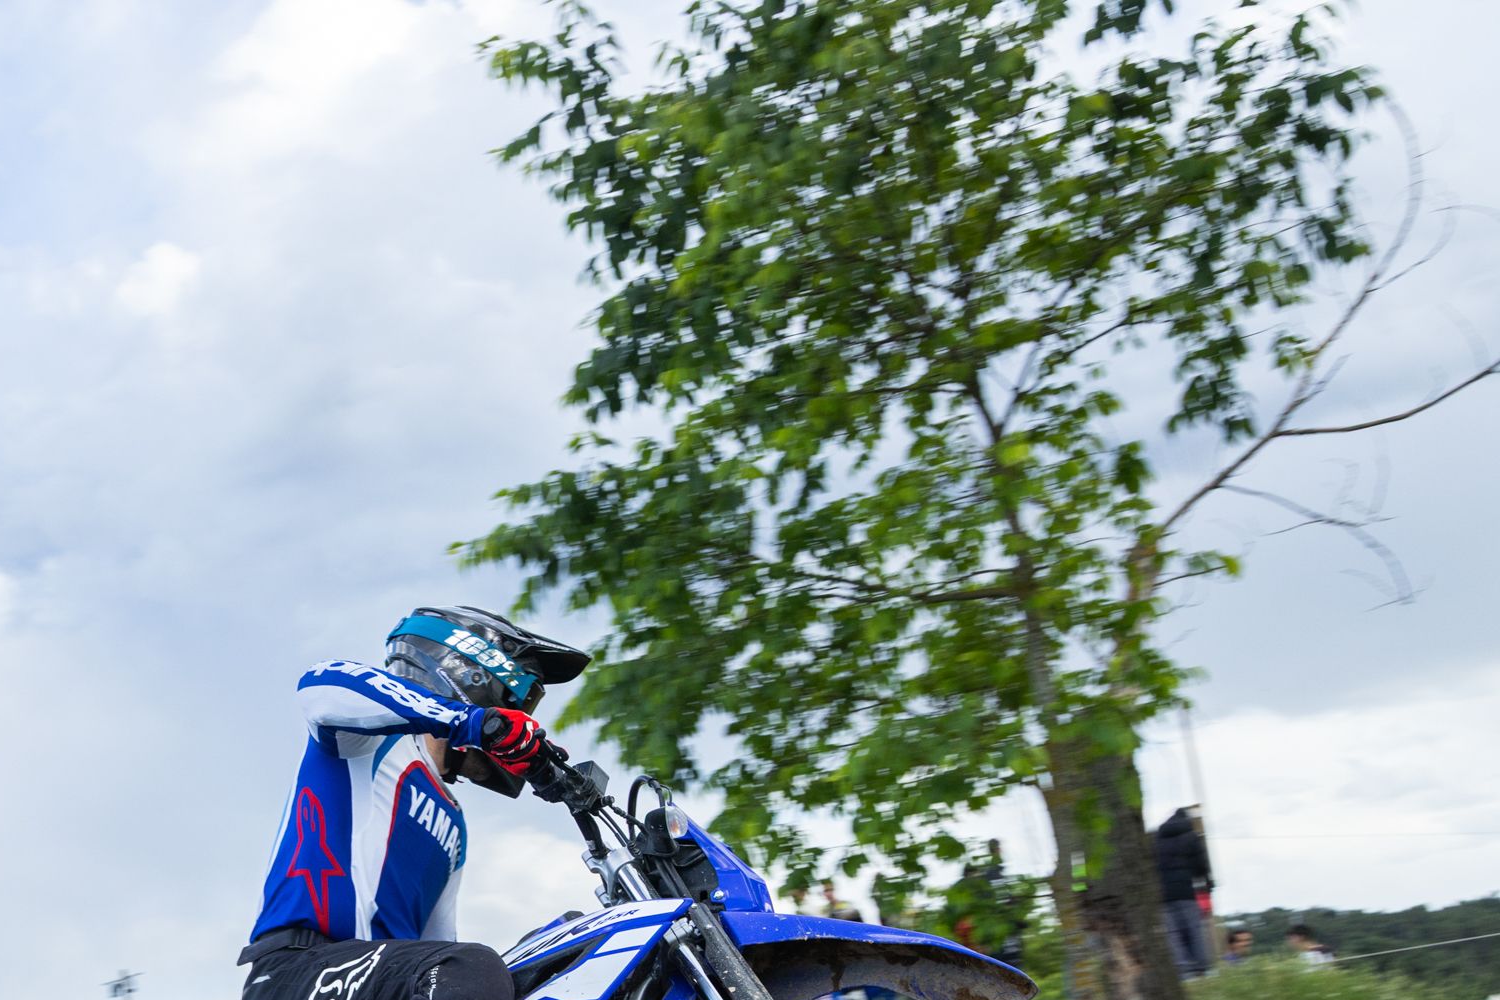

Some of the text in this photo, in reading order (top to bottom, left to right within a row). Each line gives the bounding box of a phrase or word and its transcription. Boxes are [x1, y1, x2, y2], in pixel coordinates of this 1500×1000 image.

[444, 628, 526, 687] 100%
[306, 659, 469, 726] pinestars
[408, 784, 465, 872] YAMA
